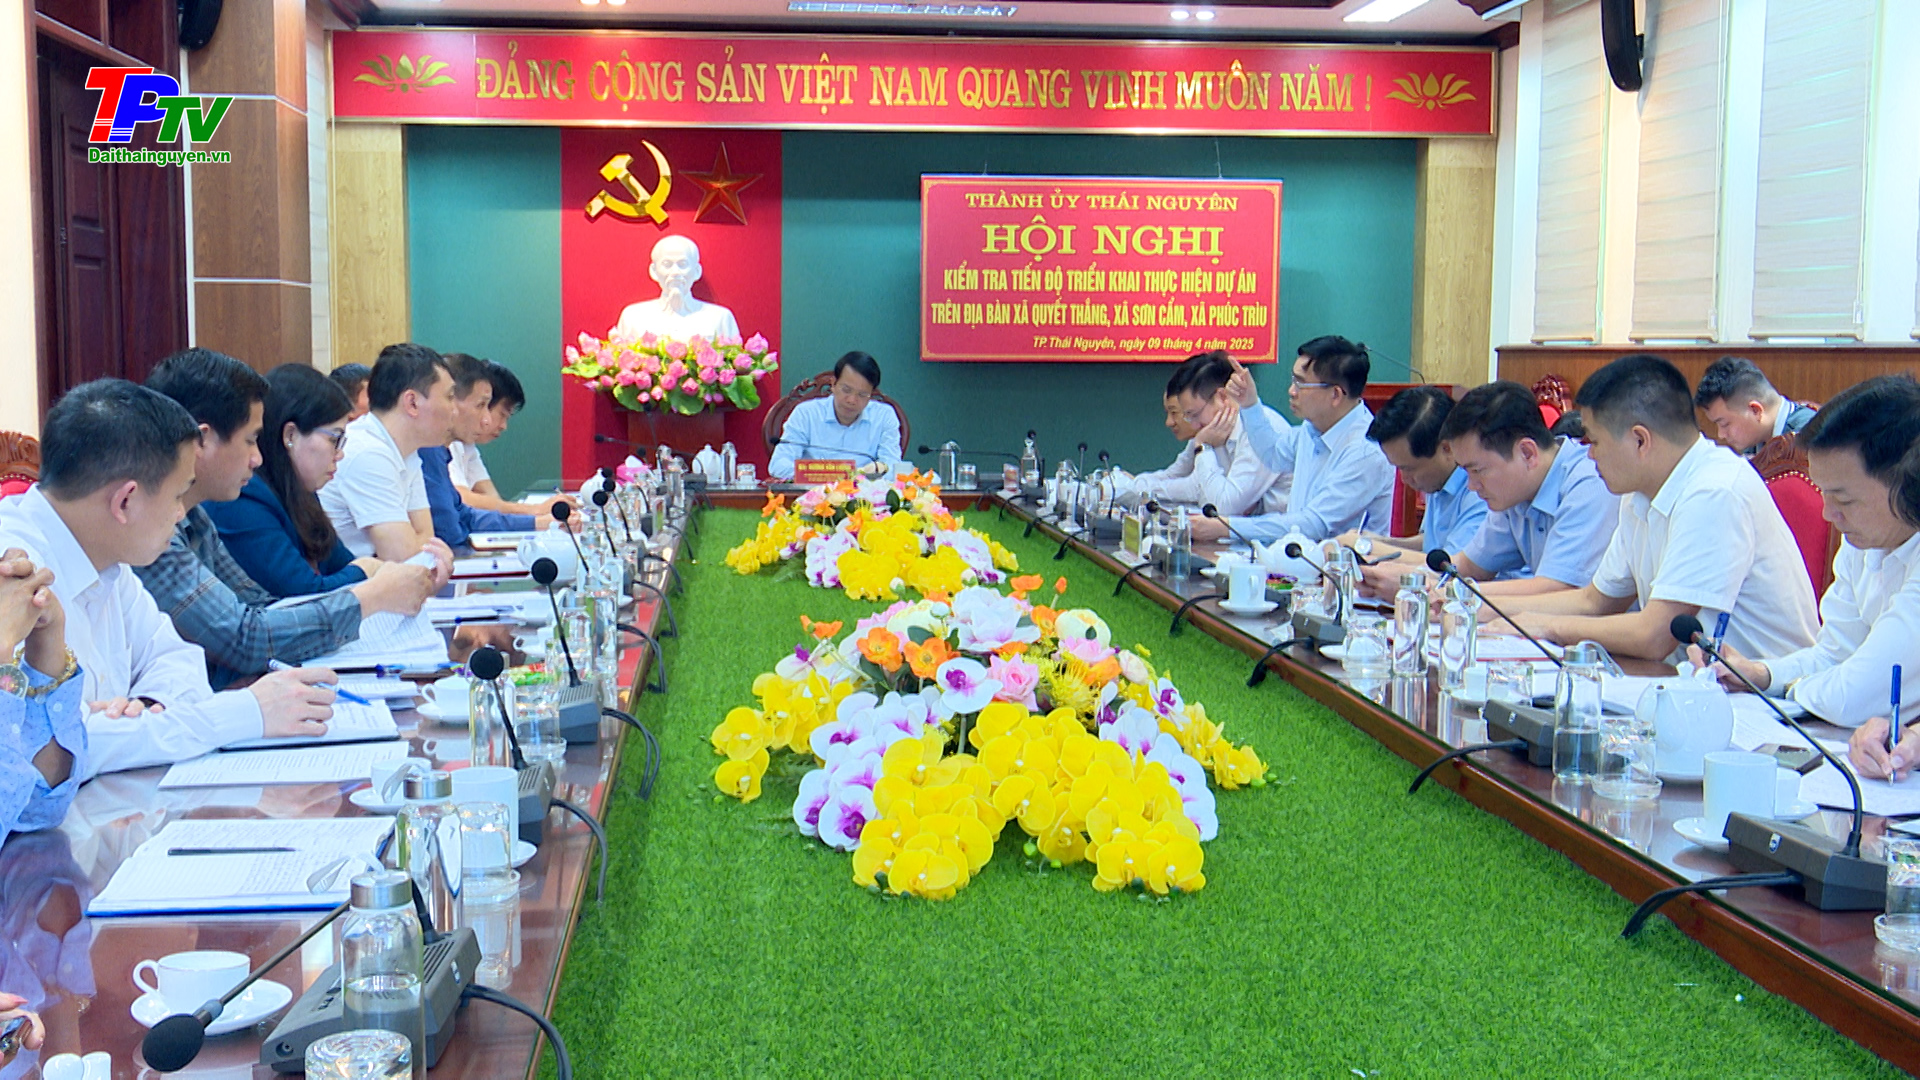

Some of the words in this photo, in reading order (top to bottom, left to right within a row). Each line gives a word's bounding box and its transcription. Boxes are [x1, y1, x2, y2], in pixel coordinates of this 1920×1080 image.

[476, 41, 576, 99] ĐẢNG
[589, 49, 686, 112] CỘNG
[697, 46, 766, 103] SẢN
[775, 52, 858, 115] VIỆT
[869, 66, 949, 106] NAM
[957, 66, 1071, 108] QUANG
[1080, 69, 1167, 110] VINH
[1174, 58, 1272, 111] MUÔN
[1280, 63, 1354, 112] NĂM
[1364, 74, 1372, 112] !
[965, 189, 1044, 208] THÀNH
[1050, 188, 1081, 209] ỦY
[1086, 190, 1139, 210] THÁI
[1146, 192, 1239, 211] NGUYÊN
[981, 214, 1076, 262] HỘI
[1092, 225, 1224, 264] NGHỊ
[944, 260, 978, 290] KIỂM
[982, 269, 1008, 291] TRA
[1011, 261, 1041, 291] TIẾN
[1044, 265, 1063, 296] ĐỘ
[1066, 261, 1106, 292] TRIỂN
[1108, 270, 1140, 292] KHAI
[1143, 269, 1178, 297] THỰC
[1181, 267, 1212, 298] HIỆN
[1215, 269, 1236, 298] DỰ
[1237, 267, 1256, 293] ÁN
[931, 298, 961, 324] TRÊN
[963, 303, 983, 329] ĐỊA
[986, 299, 1010, 324] BÀN
[1013, 299, 1029, 324] XÃ
[1032, 296, 1067, 327] QUYẾT
[1070, 298, 1110, 327] THẮNG,
[1113, 300, 1130, 326] XÃ
[1132, 303, 1156, 326] SƠN
[1159, 296, 1188, 329] CẨM,
[1191, 301, 1206, 326] XÃ
[1209, 301, 1239, 327] PHÚC
[1242, 301, 1267, 327] TRÌU
[1033, 336, 1048, 348] TP.
[1049, 336, 1072, 348] Thái
[1073, 336, 1116, 351] Nguyên,
[1119, 336, 1146, 351] ngày
[1148, 338, 1161, 350] 09
[1163, 337, 1193, 352] tháng
[1195, 338, 1202, 349] 4
[1204, 338, 1227, 350] năm
[1230, 338, 1254, 350] 2025
